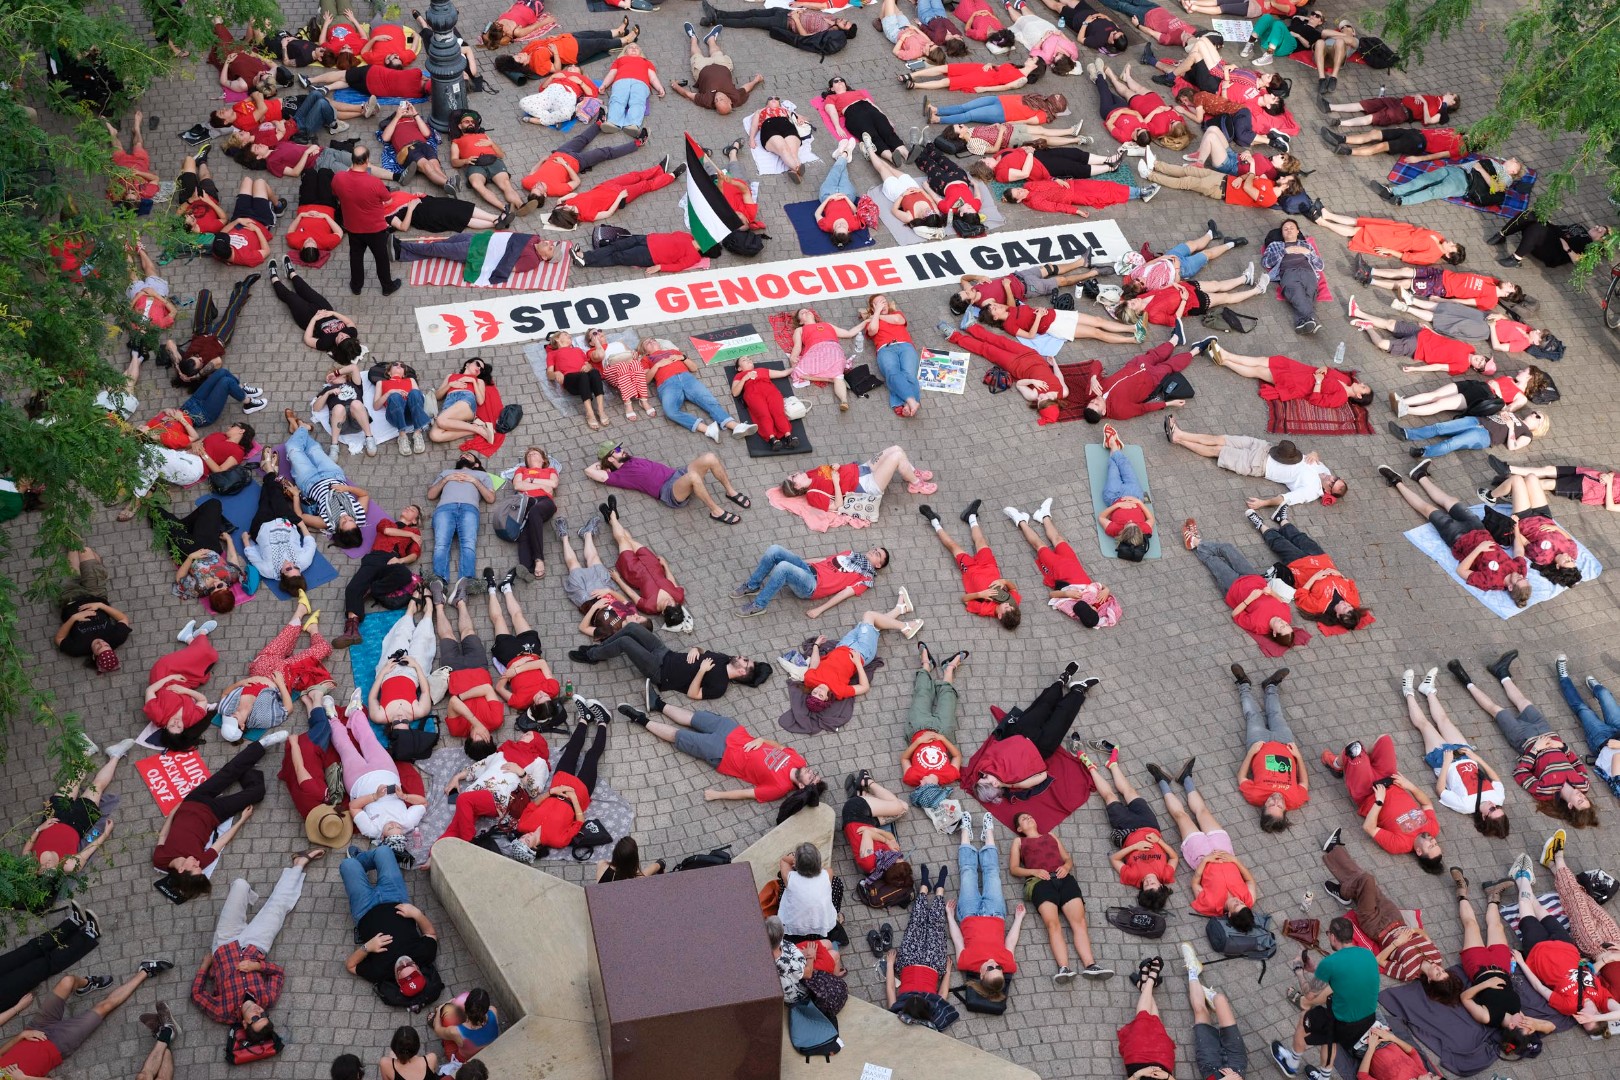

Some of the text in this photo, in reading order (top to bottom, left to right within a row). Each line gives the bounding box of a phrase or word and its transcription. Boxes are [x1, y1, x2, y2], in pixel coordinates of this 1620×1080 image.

[509, 231, 1107, 334] STOP GENOCIDE IN GAZA!
[727, 344, 762, 355] PRAVDA
[146, 768, 175, 803] ZAŠTO
